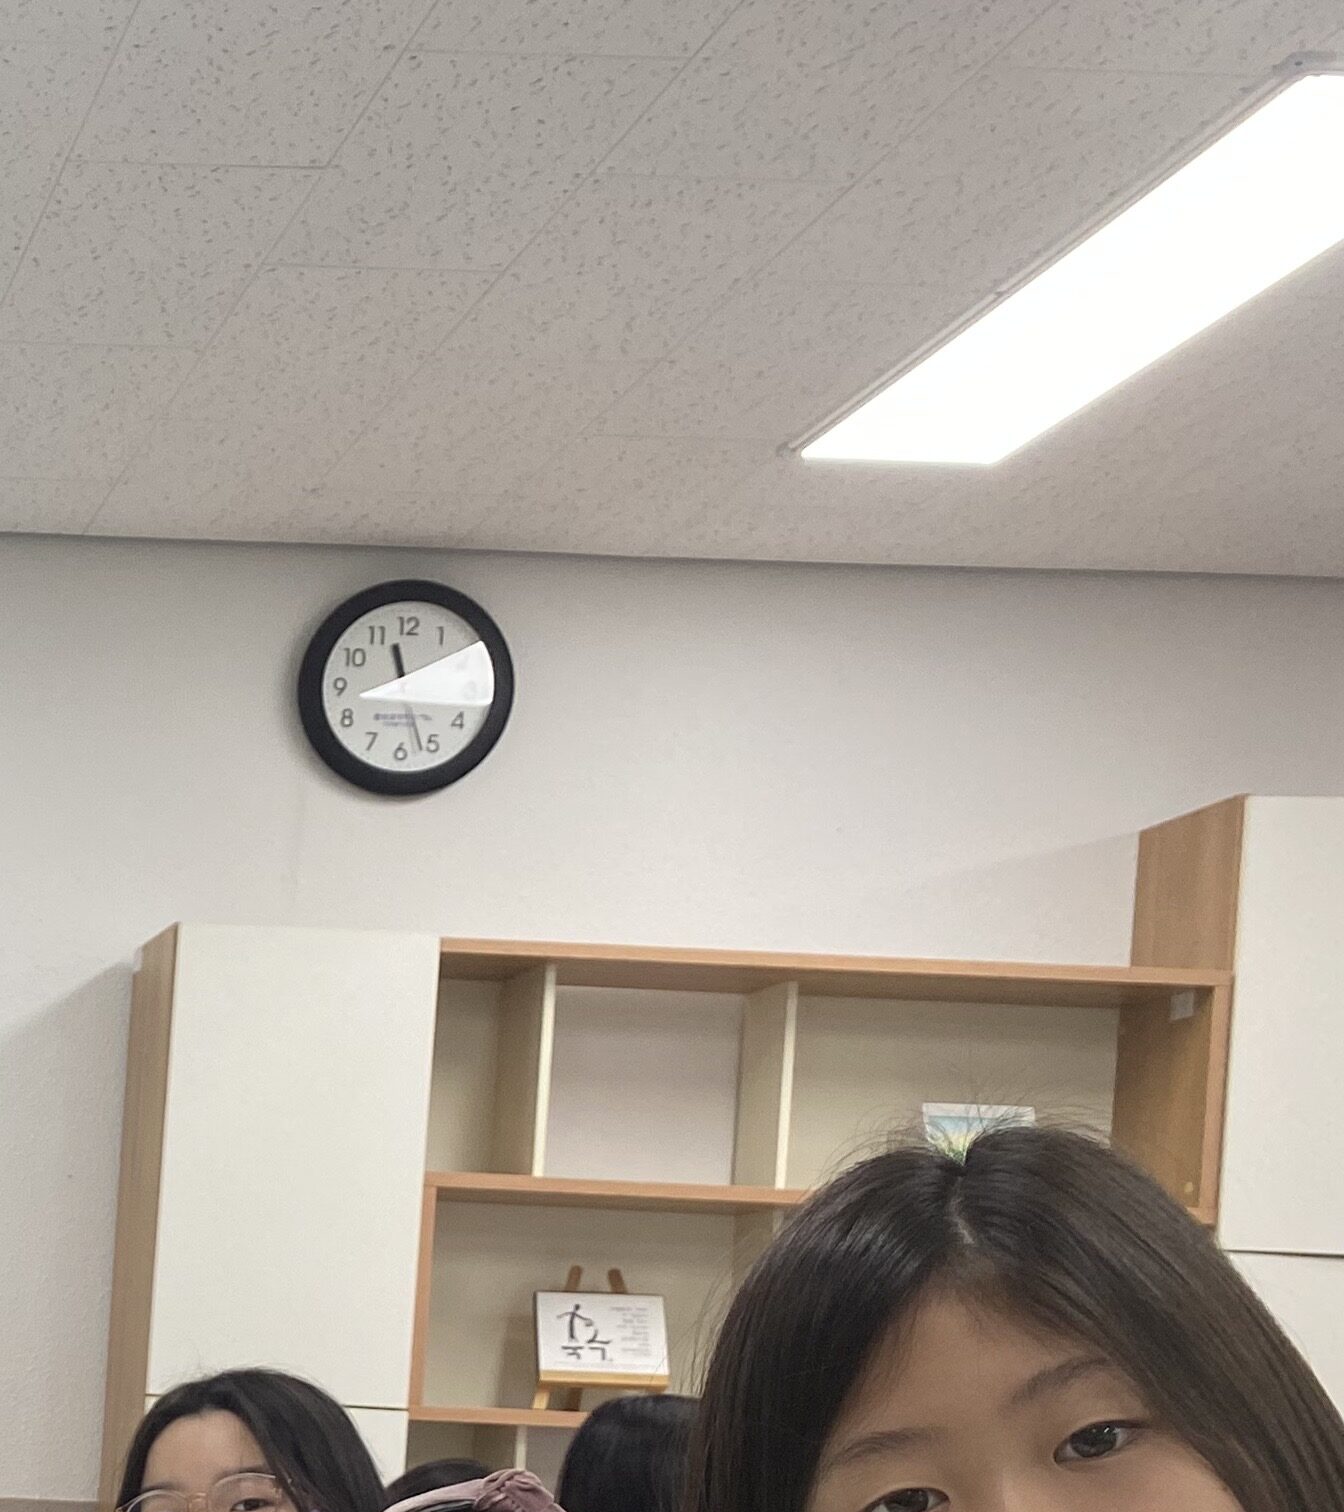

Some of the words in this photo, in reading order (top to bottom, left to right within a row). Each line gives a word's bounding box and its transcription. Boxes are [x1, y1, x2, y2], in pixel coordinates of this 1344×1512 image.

[368, 626, 386, 645] 11
[397, 616, 420, 636] 12
[437, 626, 444, 645] 1
[344, 648, 366, 667] 10
[333, 677, 347, 696] 9
[340, 708, 354, 727] 8
[450, 711, 464, 729] 4
[365, 732, 378, 751] 7
[426, 734, 440, 753] 5
[393, 742, 408, 761] 6
